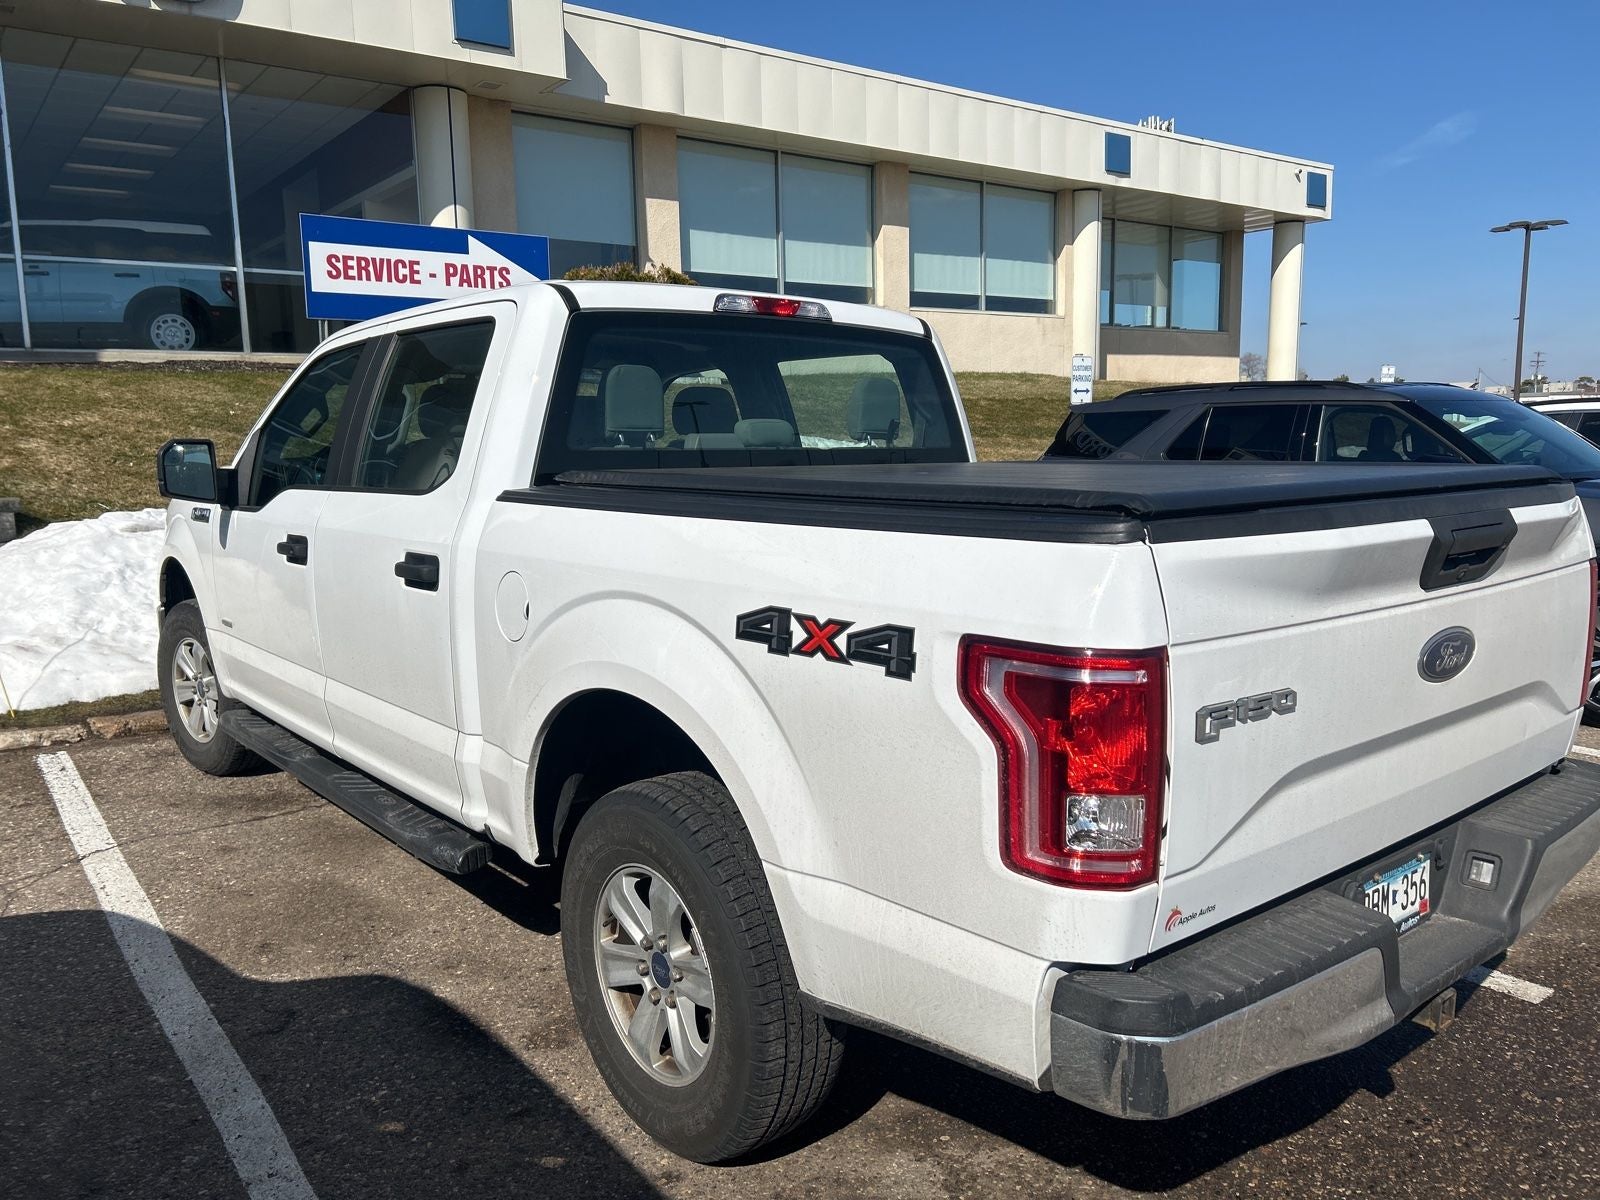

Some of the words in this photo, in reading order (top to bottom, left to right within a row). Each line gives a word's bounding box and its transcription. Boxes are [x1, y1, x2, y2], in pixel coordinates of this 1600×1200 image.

[326, 253, 422, 285] SERVICE
[444, 262, 512, 290] PARTS
[1072, 374, 1091, 383] PARKING
[1400, 866, 1427, 911] 356
[1177, 912, 1198, 926] Apple
[1198, 904, 1217, 917] Autos
